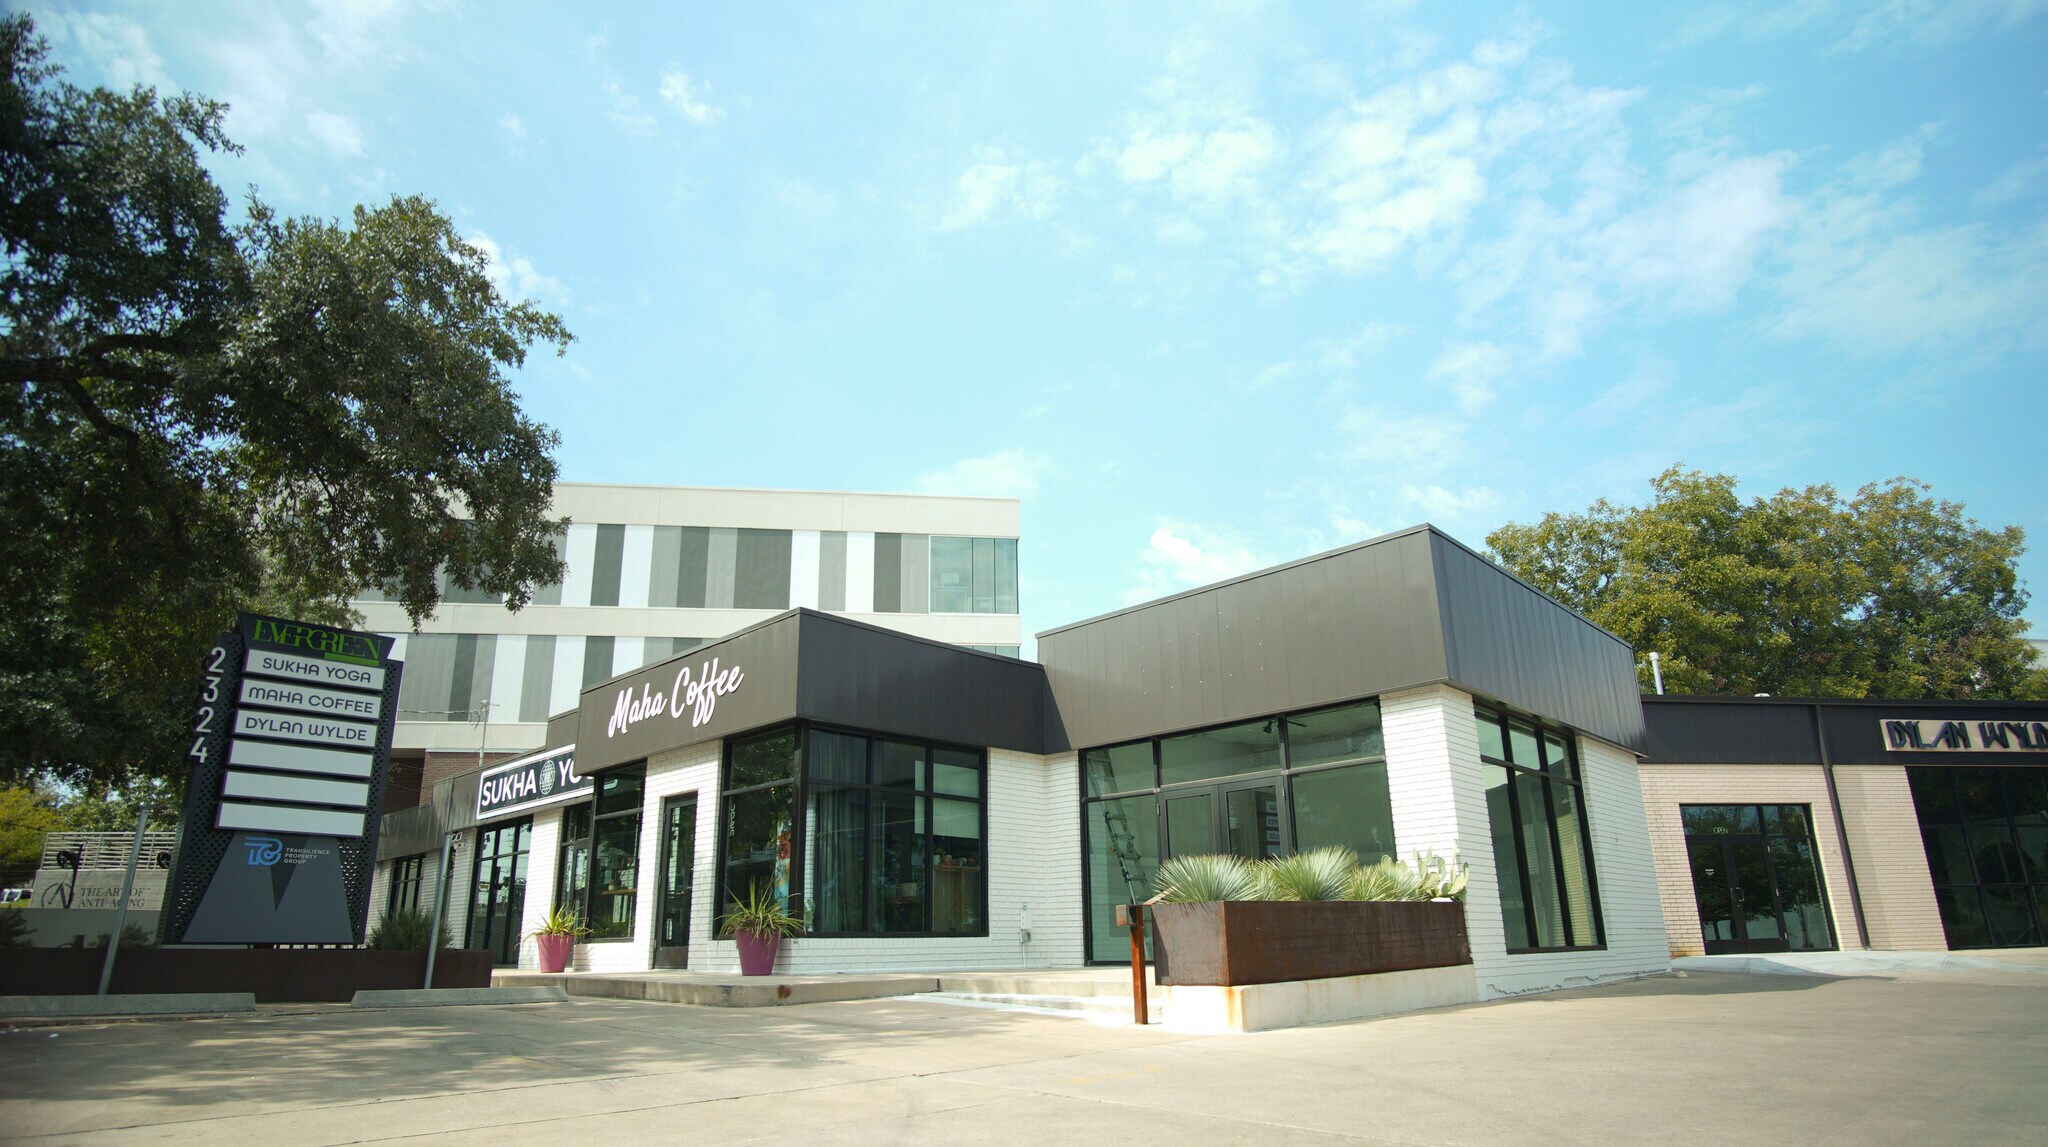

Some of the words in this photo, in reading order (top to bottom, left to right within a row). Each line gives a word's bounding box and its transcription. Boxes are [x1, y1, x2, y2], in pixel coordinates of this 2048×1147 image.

[253, 619, 381, 660] EVERGREEN
[262, 657, 320, 676] SUKHA
[326, 666, 371, 684] YOGA
[190, 646, 227, 764] 2324
[248, 686, 303, 705] MAHA
[308, 694, 375, 714] COFFEE
[607, 683, 667, 738] Maha
[671, 657, 744, 728] Coffee
[245, 716, 303, 734] DYLAN
[308, 723, 367, 741] WYLDE
[1886, 721, 1972, 749] DYLAN
[480, 768, 537, 807] SUKHA
[558, 758, 595, 787] YO
[285, 847, 331, 855] TRANSILIENCE
[78, 898, 145, 908] ANTI-AGNG
[80, 887, 104, 897] THE
[104, 887, 123, 897] AR
